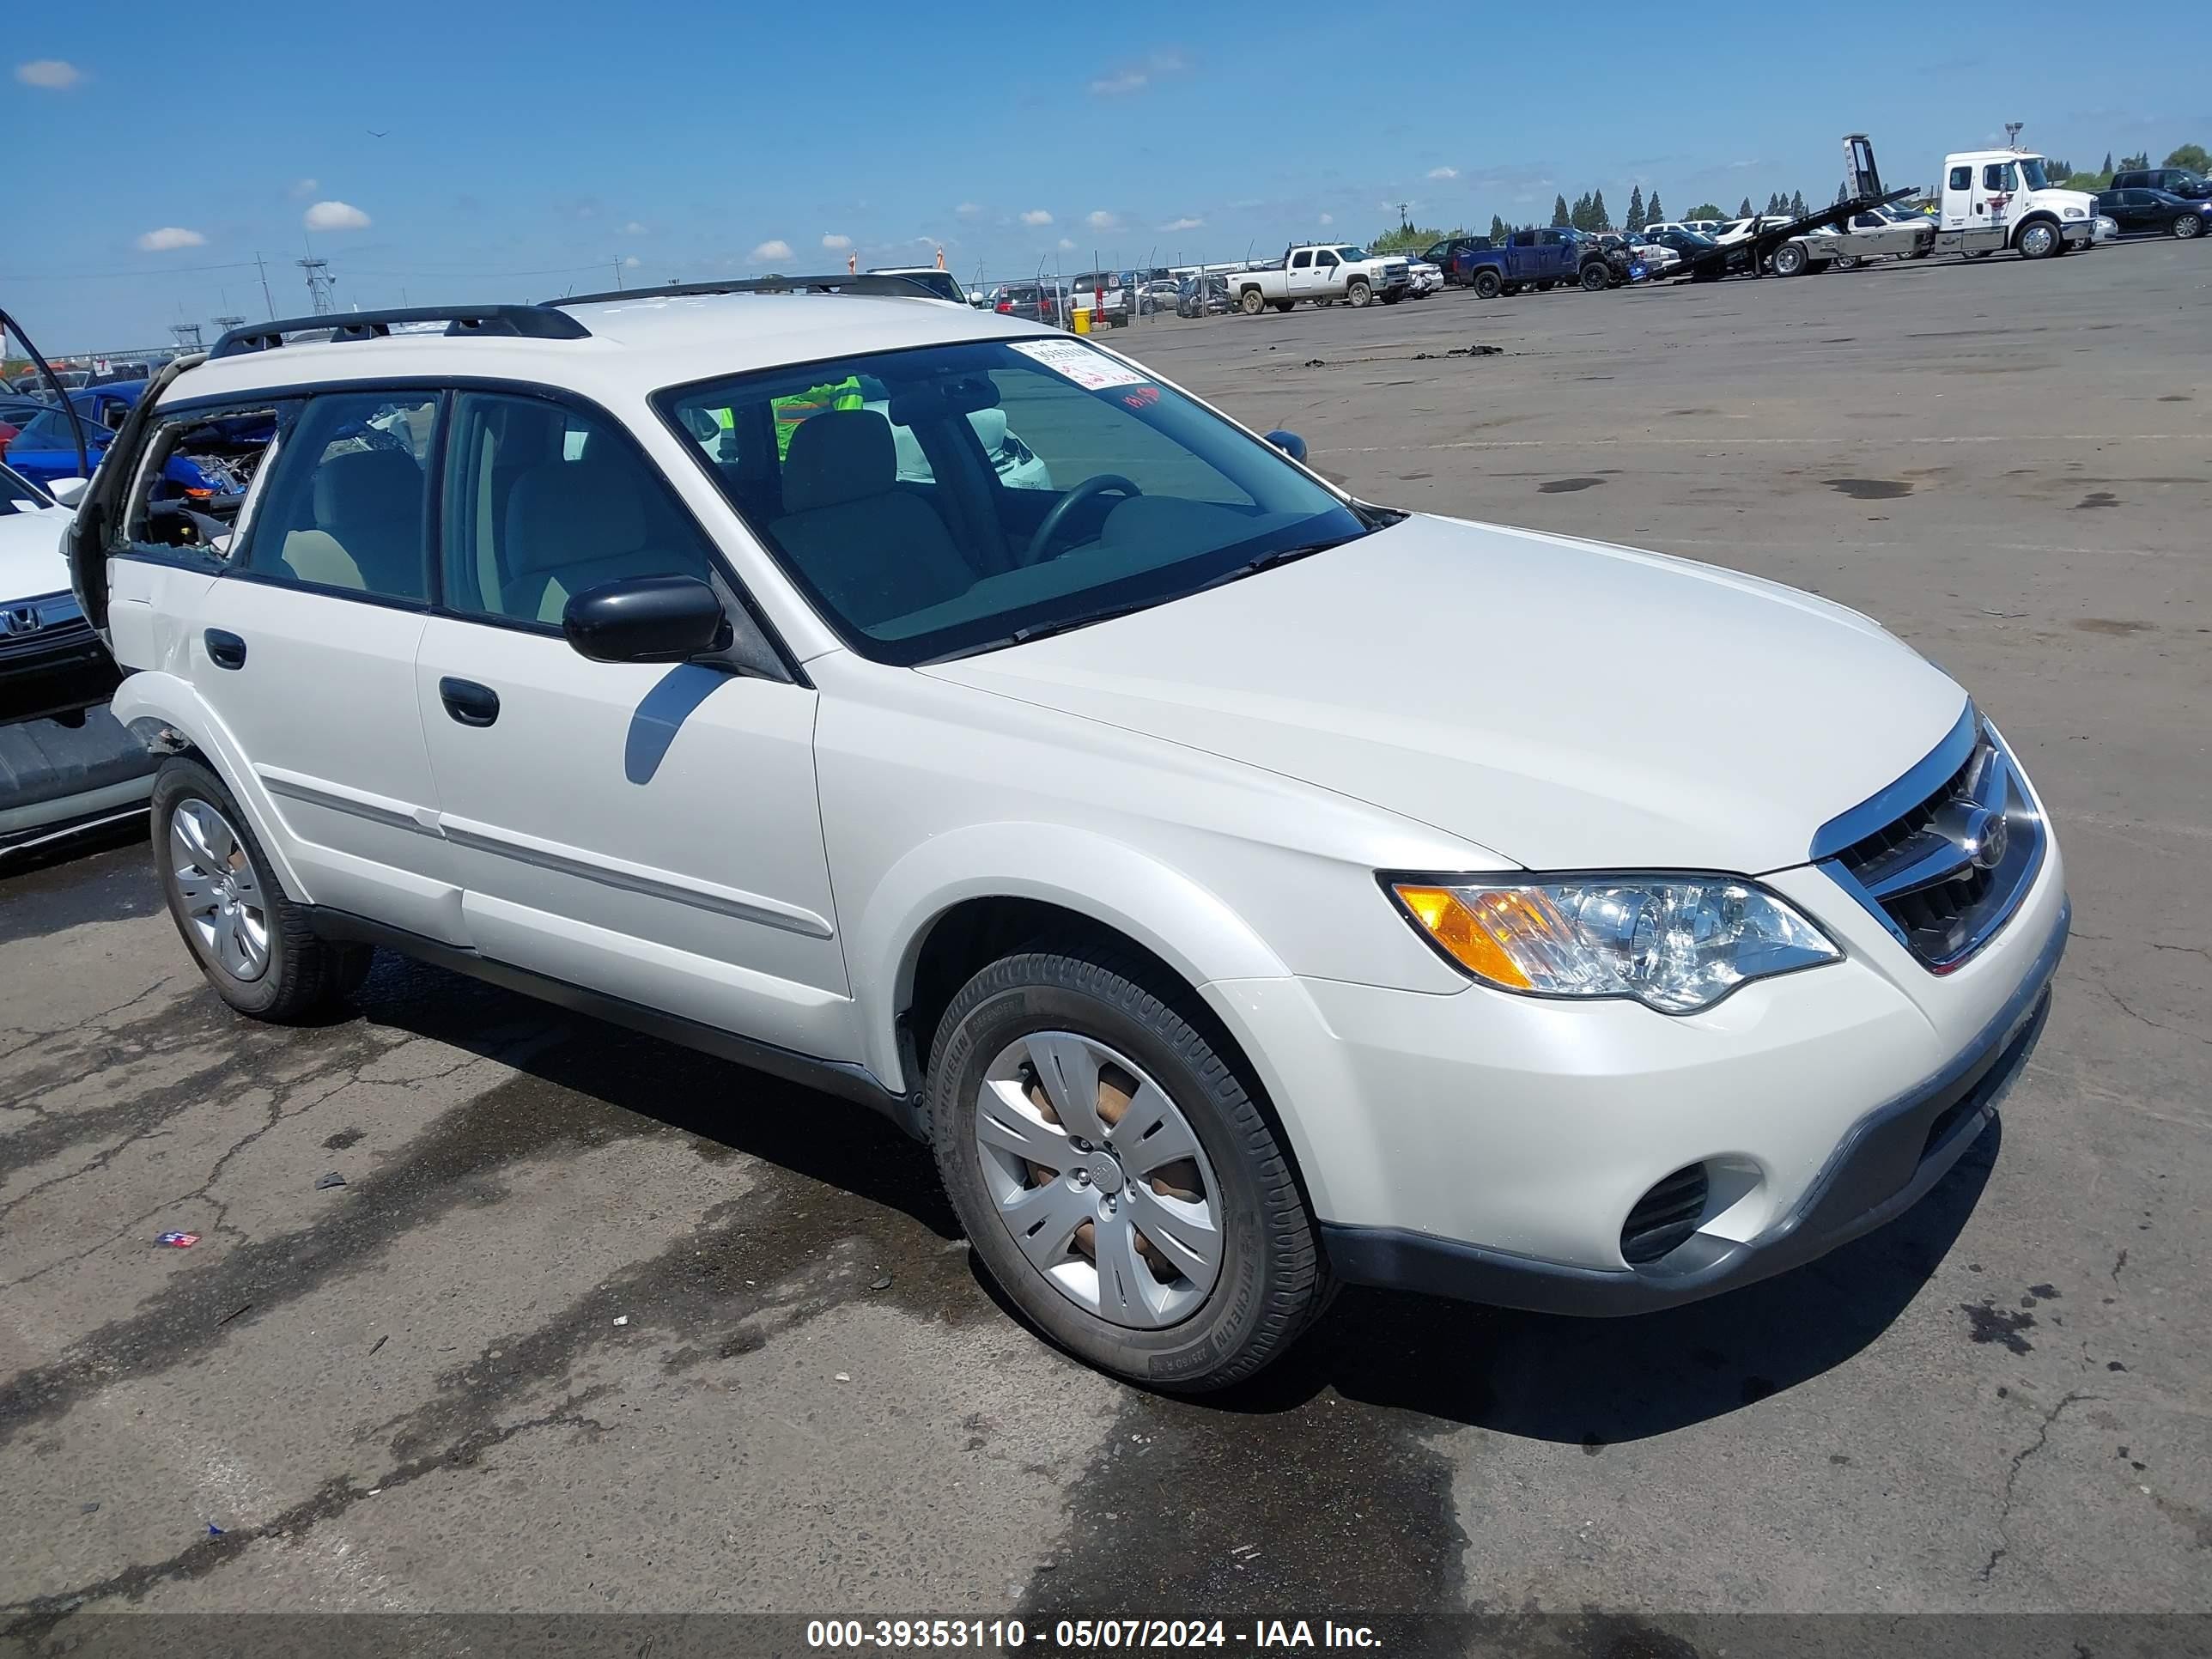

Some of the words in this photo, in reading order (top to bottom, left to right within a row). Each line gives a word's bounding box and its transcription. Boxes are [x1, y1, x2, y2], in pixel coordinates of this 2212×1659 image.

[96, 359, 106, 371] 7
[940, 1035, 969, 1115] MICHELIN
[1214, 1261, 1255, 1348] MICHELIN
